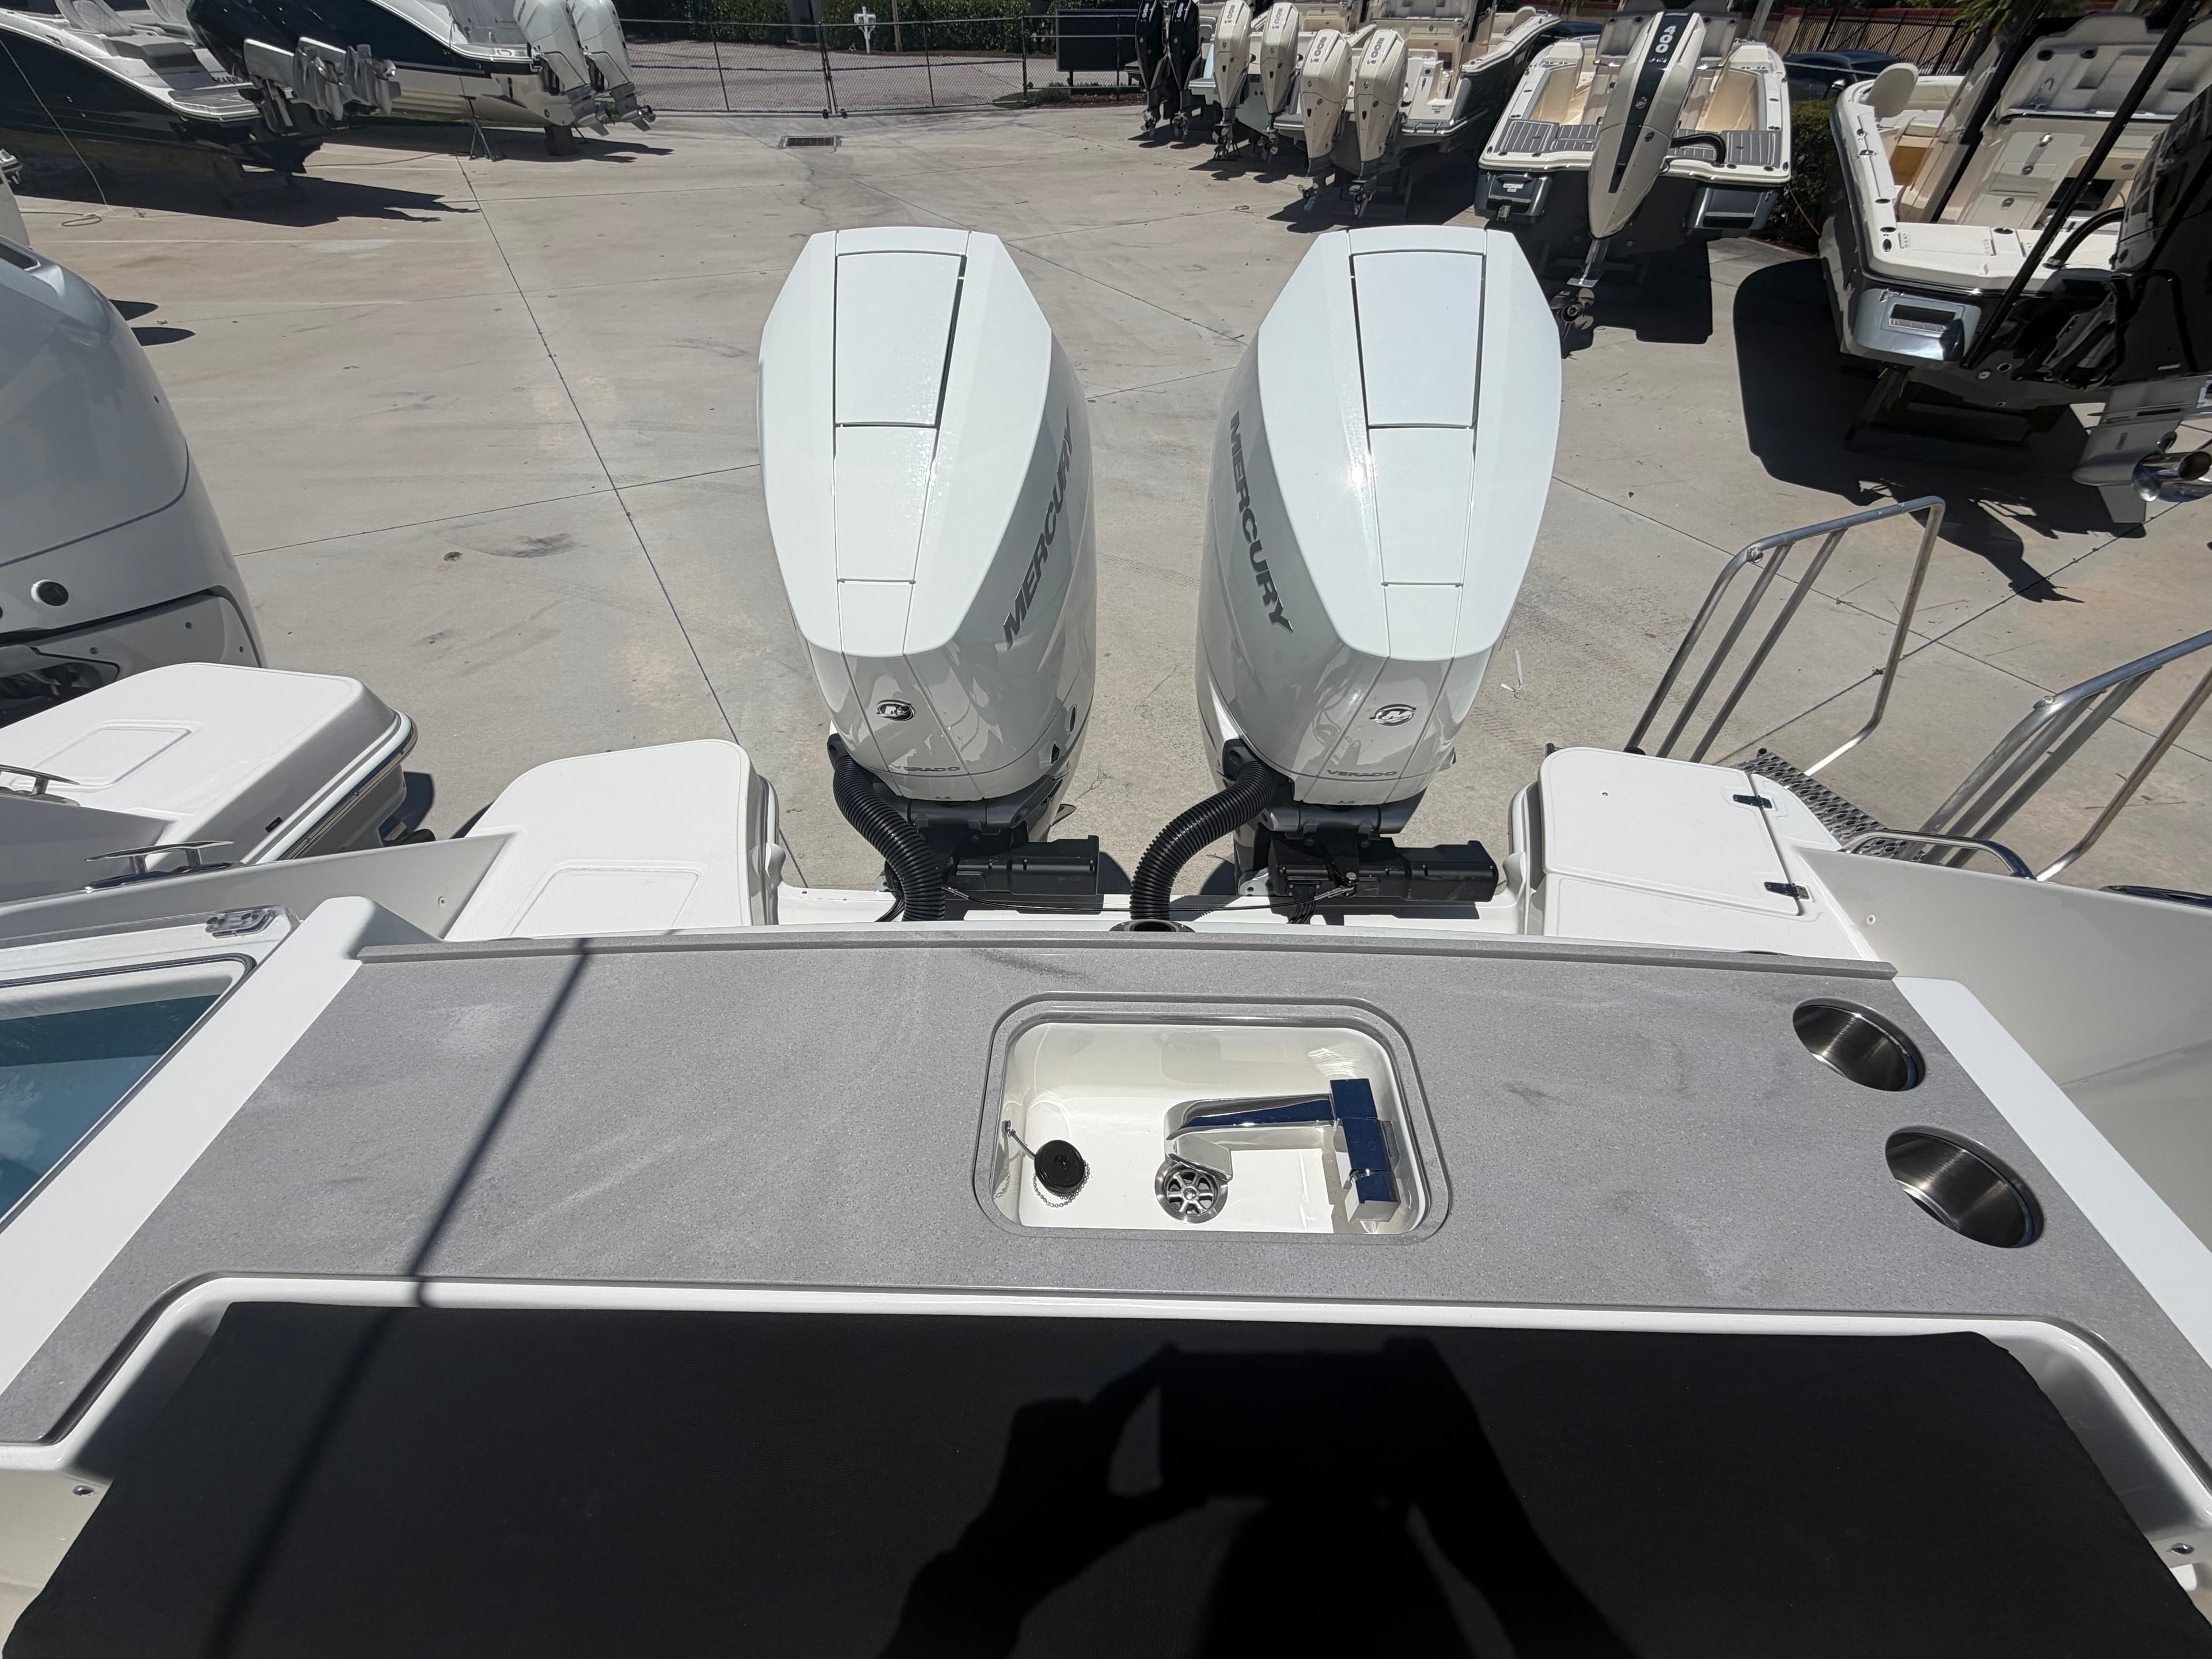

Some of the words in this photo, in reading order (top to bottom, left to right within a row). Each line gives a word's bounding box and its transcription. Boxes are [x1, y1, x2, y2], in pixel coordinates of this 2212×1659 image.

[1655, 25, 1676, 53] 400
[1003, 405, 1072, 651] MERCURY
[1230, 410, 1294, 633] MERCURY
[1327, 769, 1397, 777] VERADO
